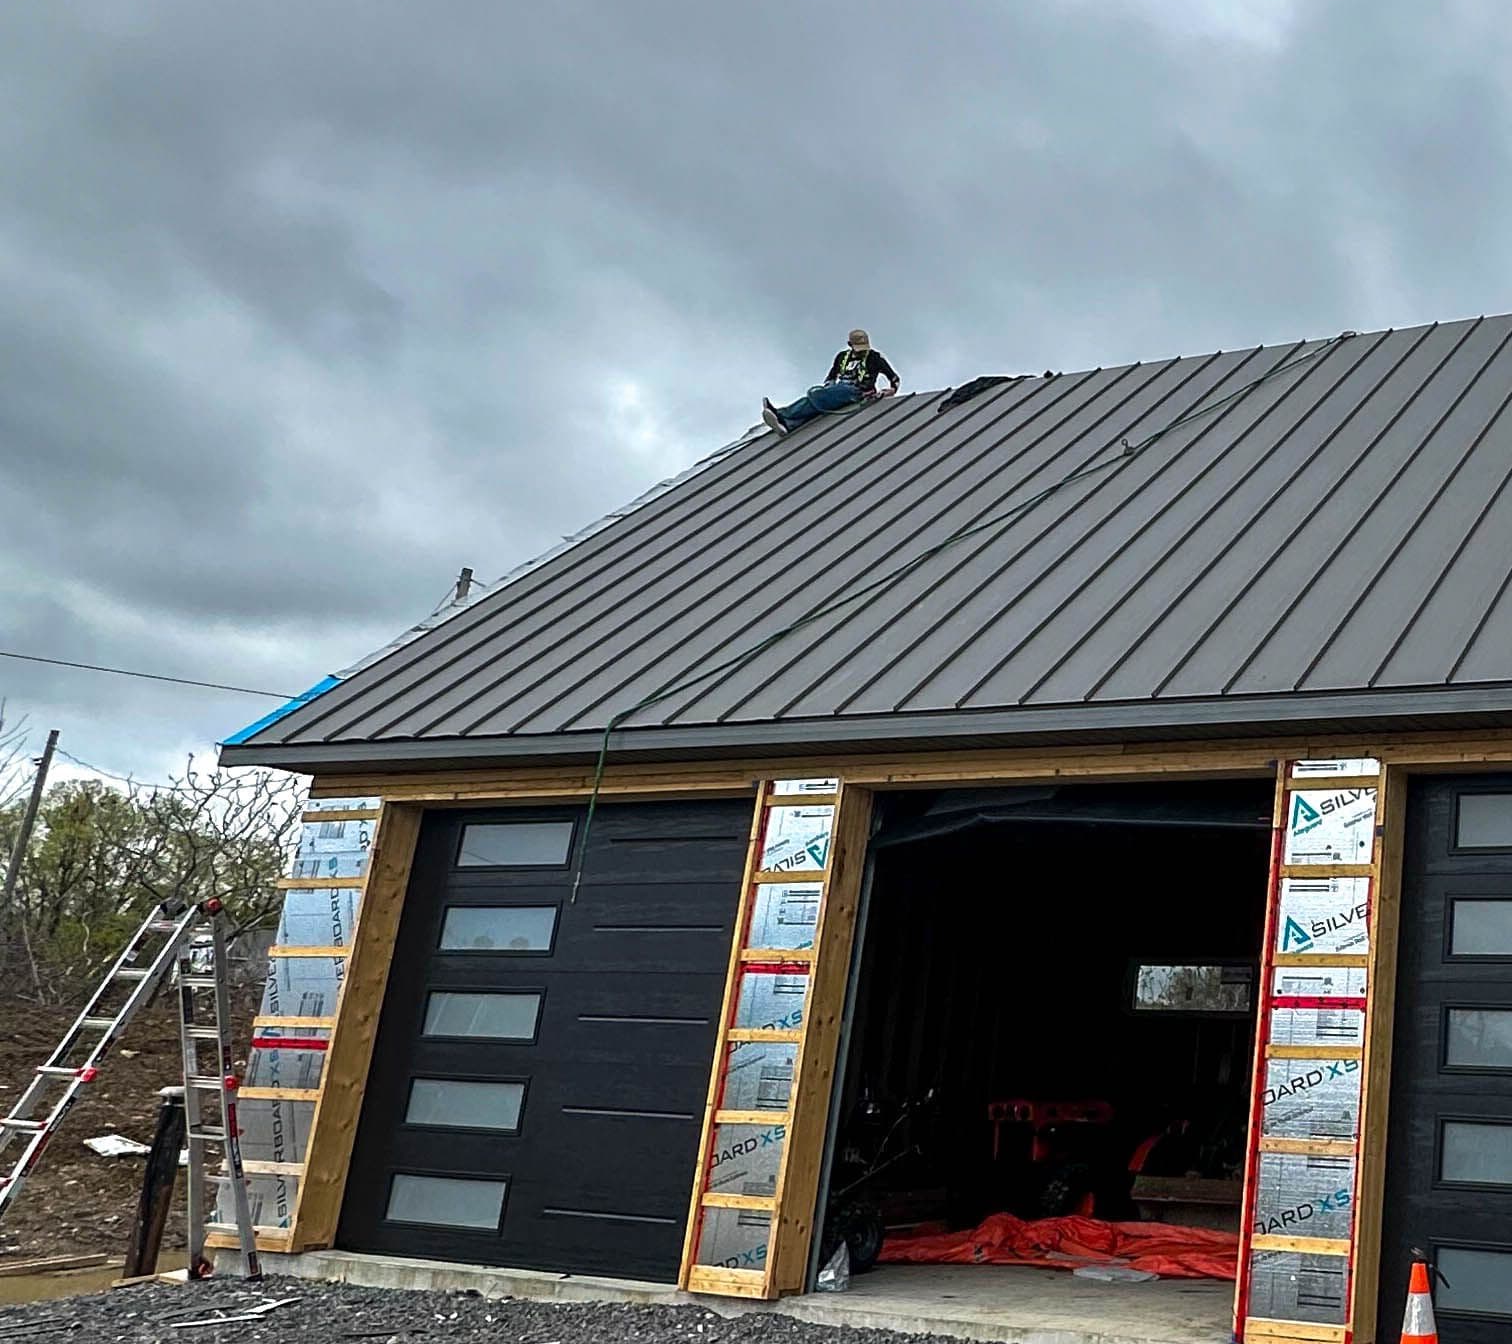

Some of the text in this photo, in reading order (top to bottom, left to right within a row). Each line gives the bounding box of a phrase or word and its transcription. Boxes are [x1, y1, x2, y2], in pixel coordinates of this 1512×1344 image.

[779, 1010, 802, 1030] XS
[1326, 1059, 1359, 1080] XS
[760, 1125, 785, 1146] XS
[1318, 1188, 1350, 1214] XS
[740, 1245, 767, 1265] XS
